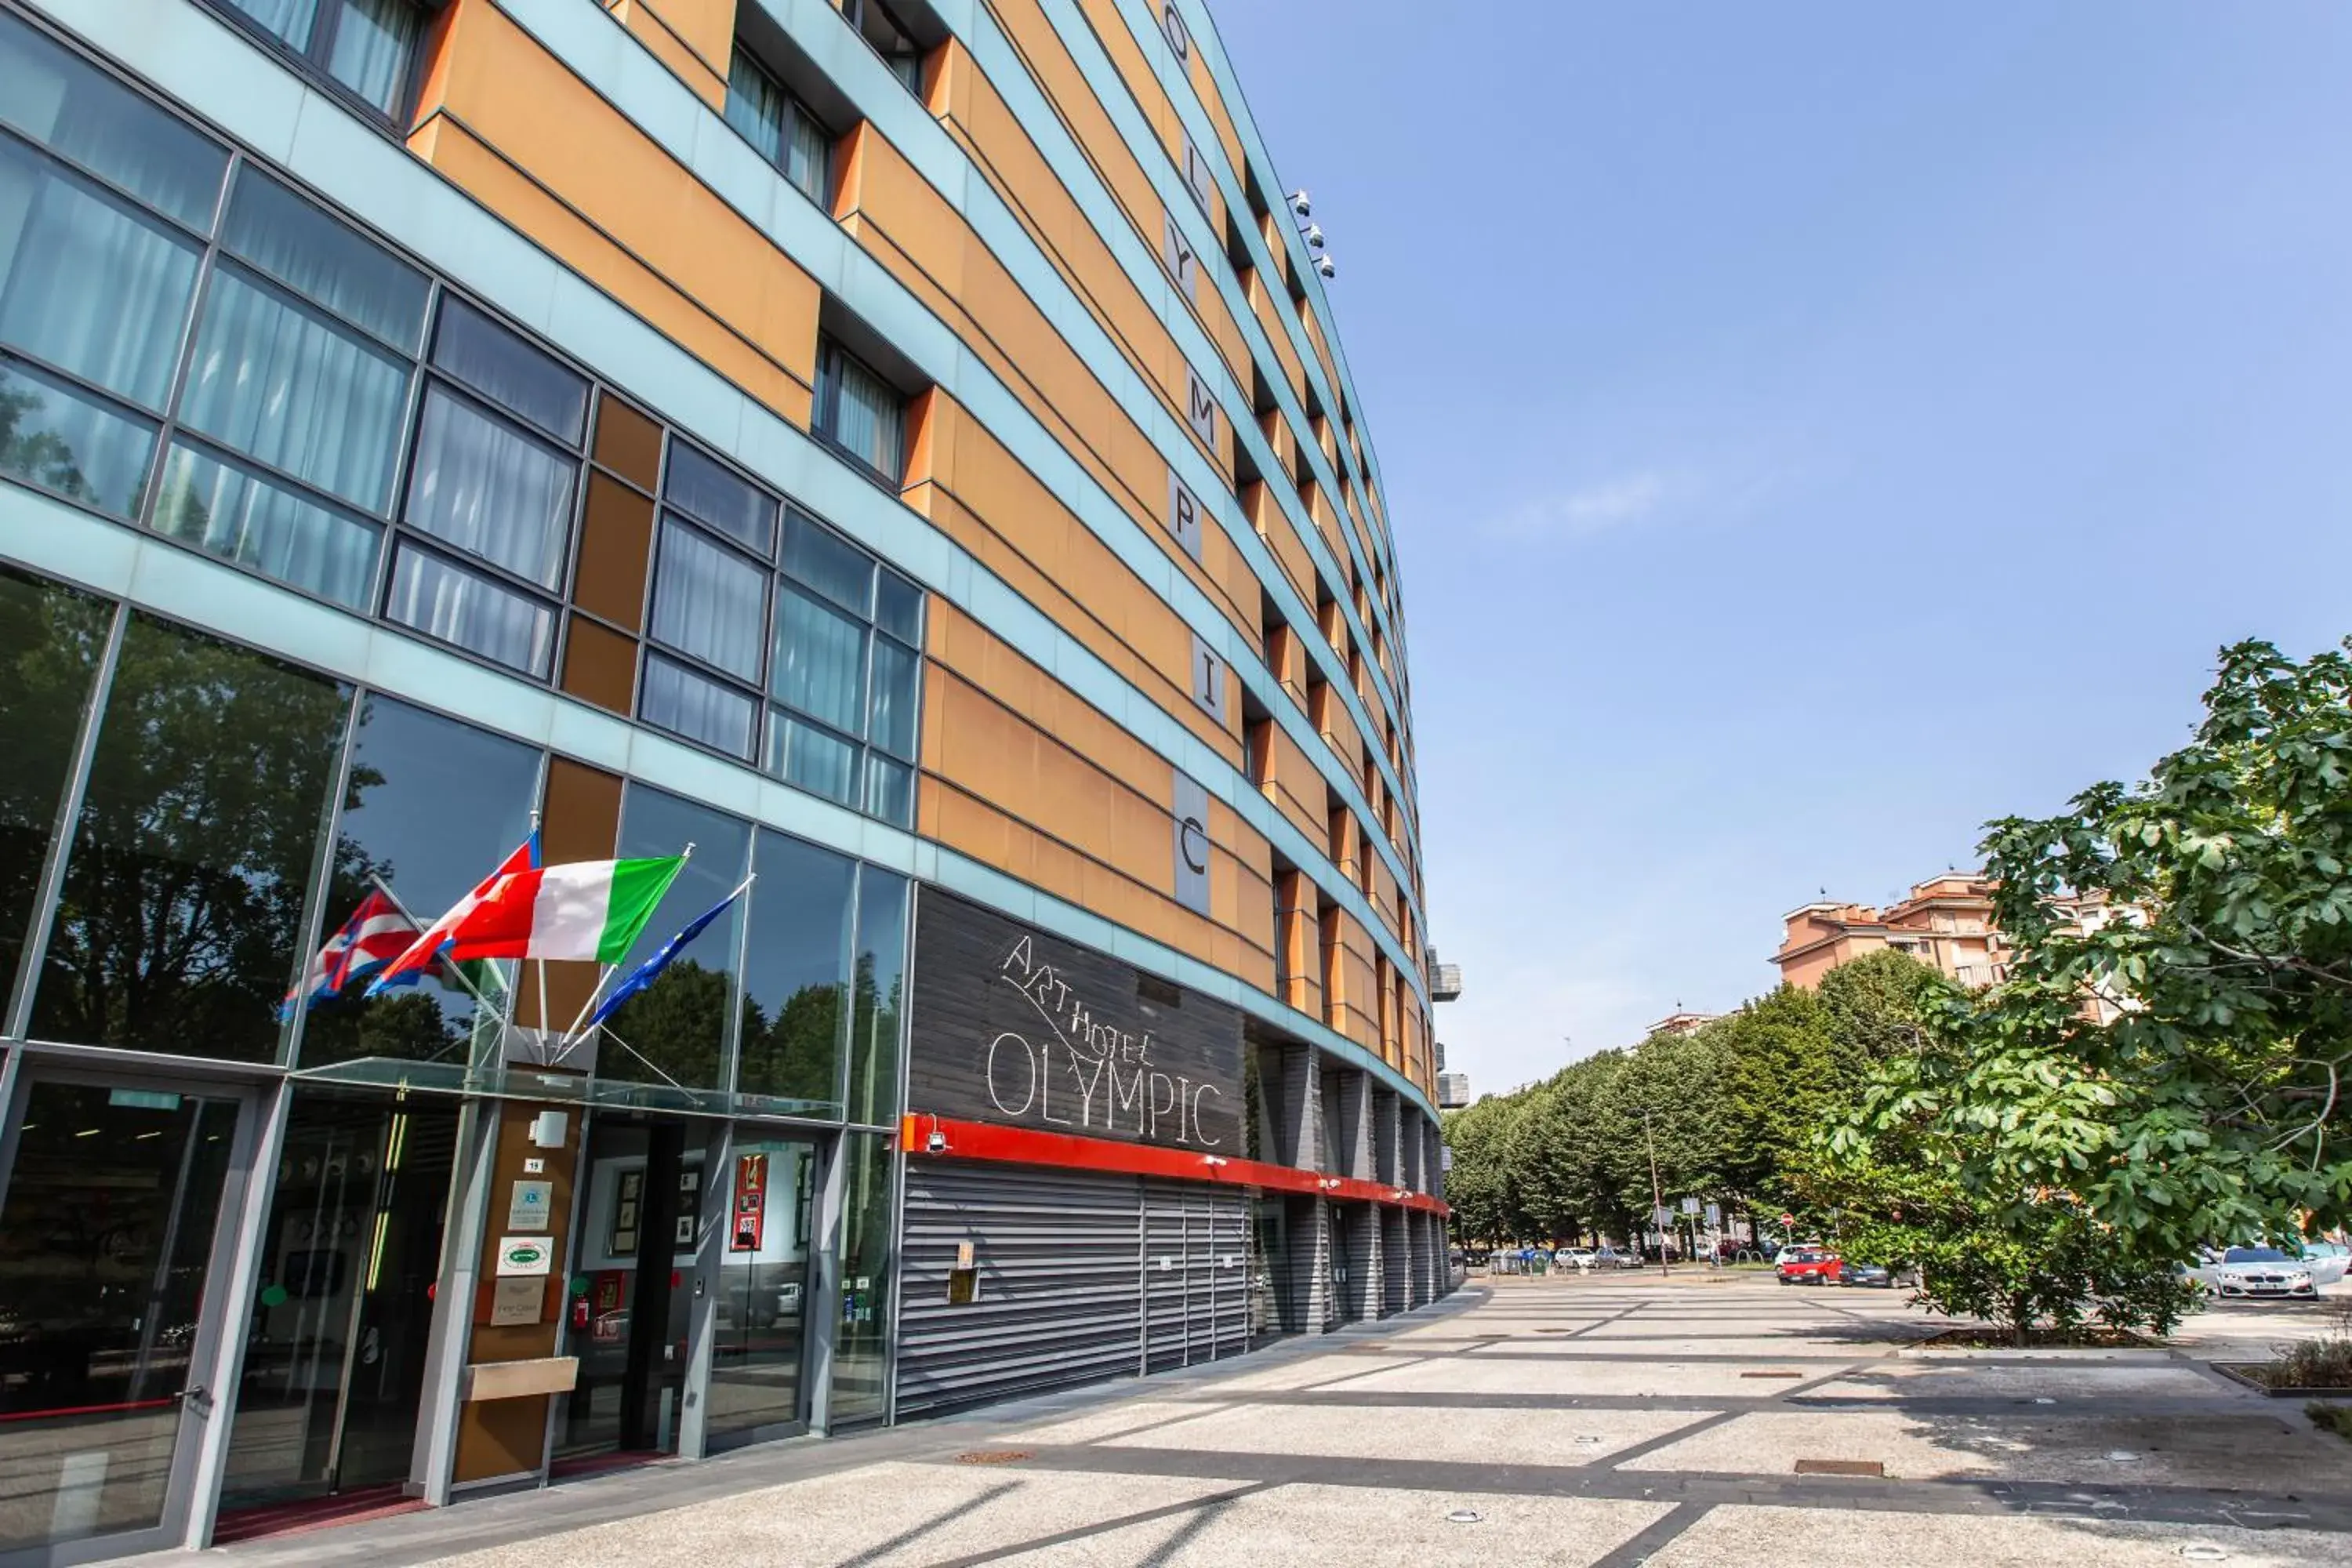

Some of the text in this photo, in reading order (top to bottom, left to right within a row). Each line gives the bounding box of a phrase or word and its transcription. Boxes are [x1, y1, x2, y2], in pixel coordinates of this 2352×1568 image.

[1003, 935, 1155, 1067] ART HOTEL
[987, 1032, 1221, 1145] OLYMPIC
